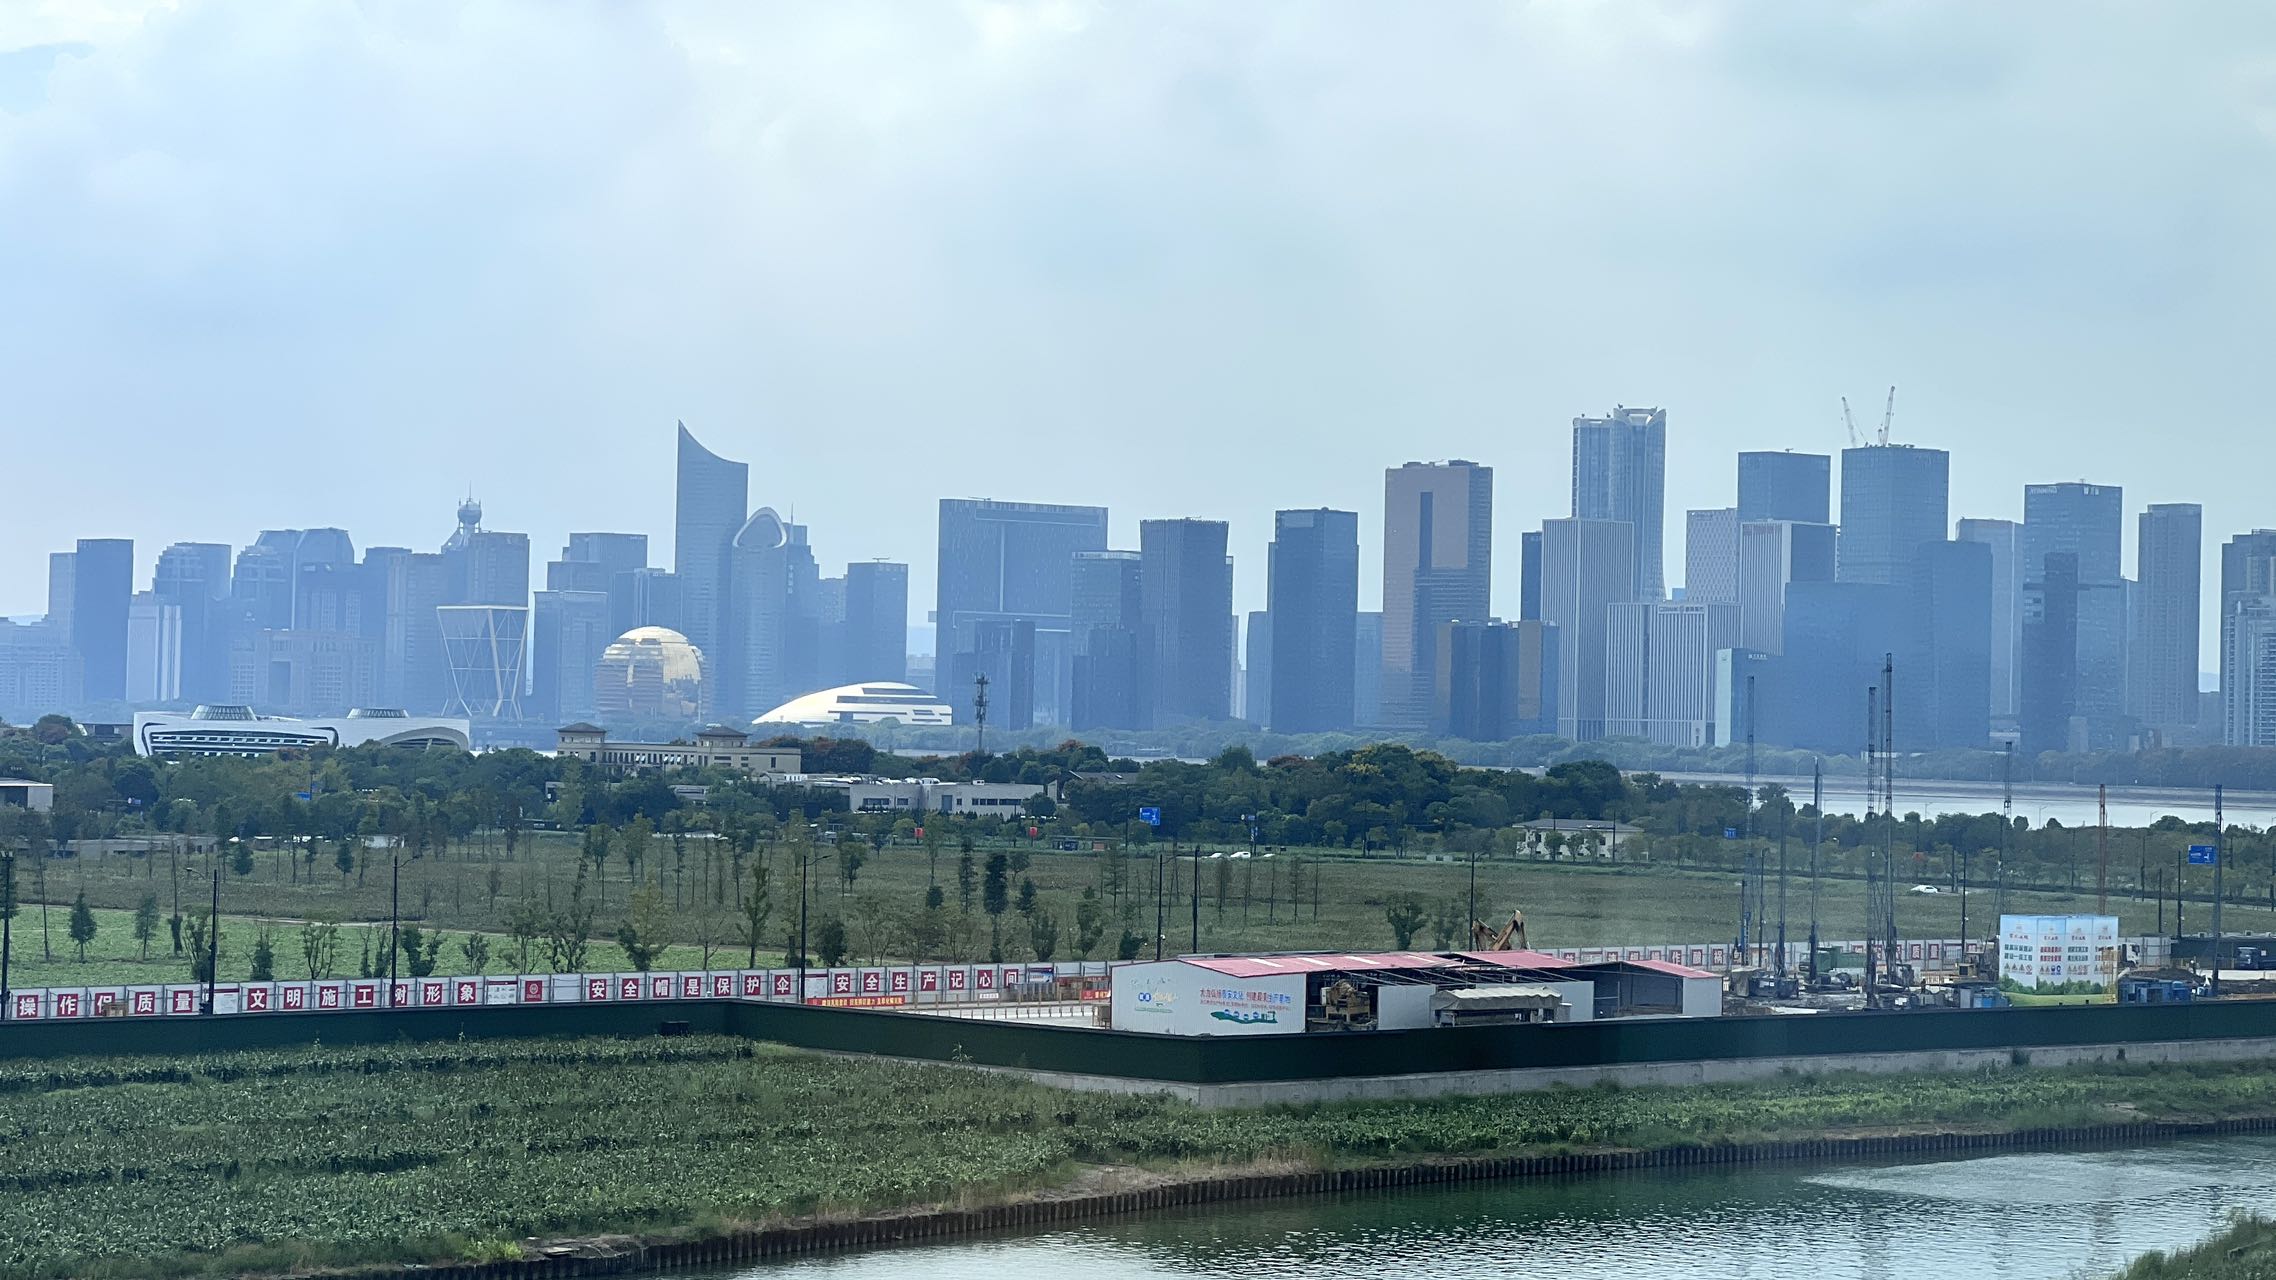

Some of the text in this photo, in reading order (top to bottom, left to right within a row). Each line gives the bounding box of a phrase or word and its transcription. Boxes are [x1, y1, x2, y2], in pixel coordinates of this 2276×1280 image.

[591, 976, 789, 998] 安全帽是保护伞
[836, 971, 1017, 991] 安全生产记心间
[250, 984, 475, 1008] 文明施工树形象
